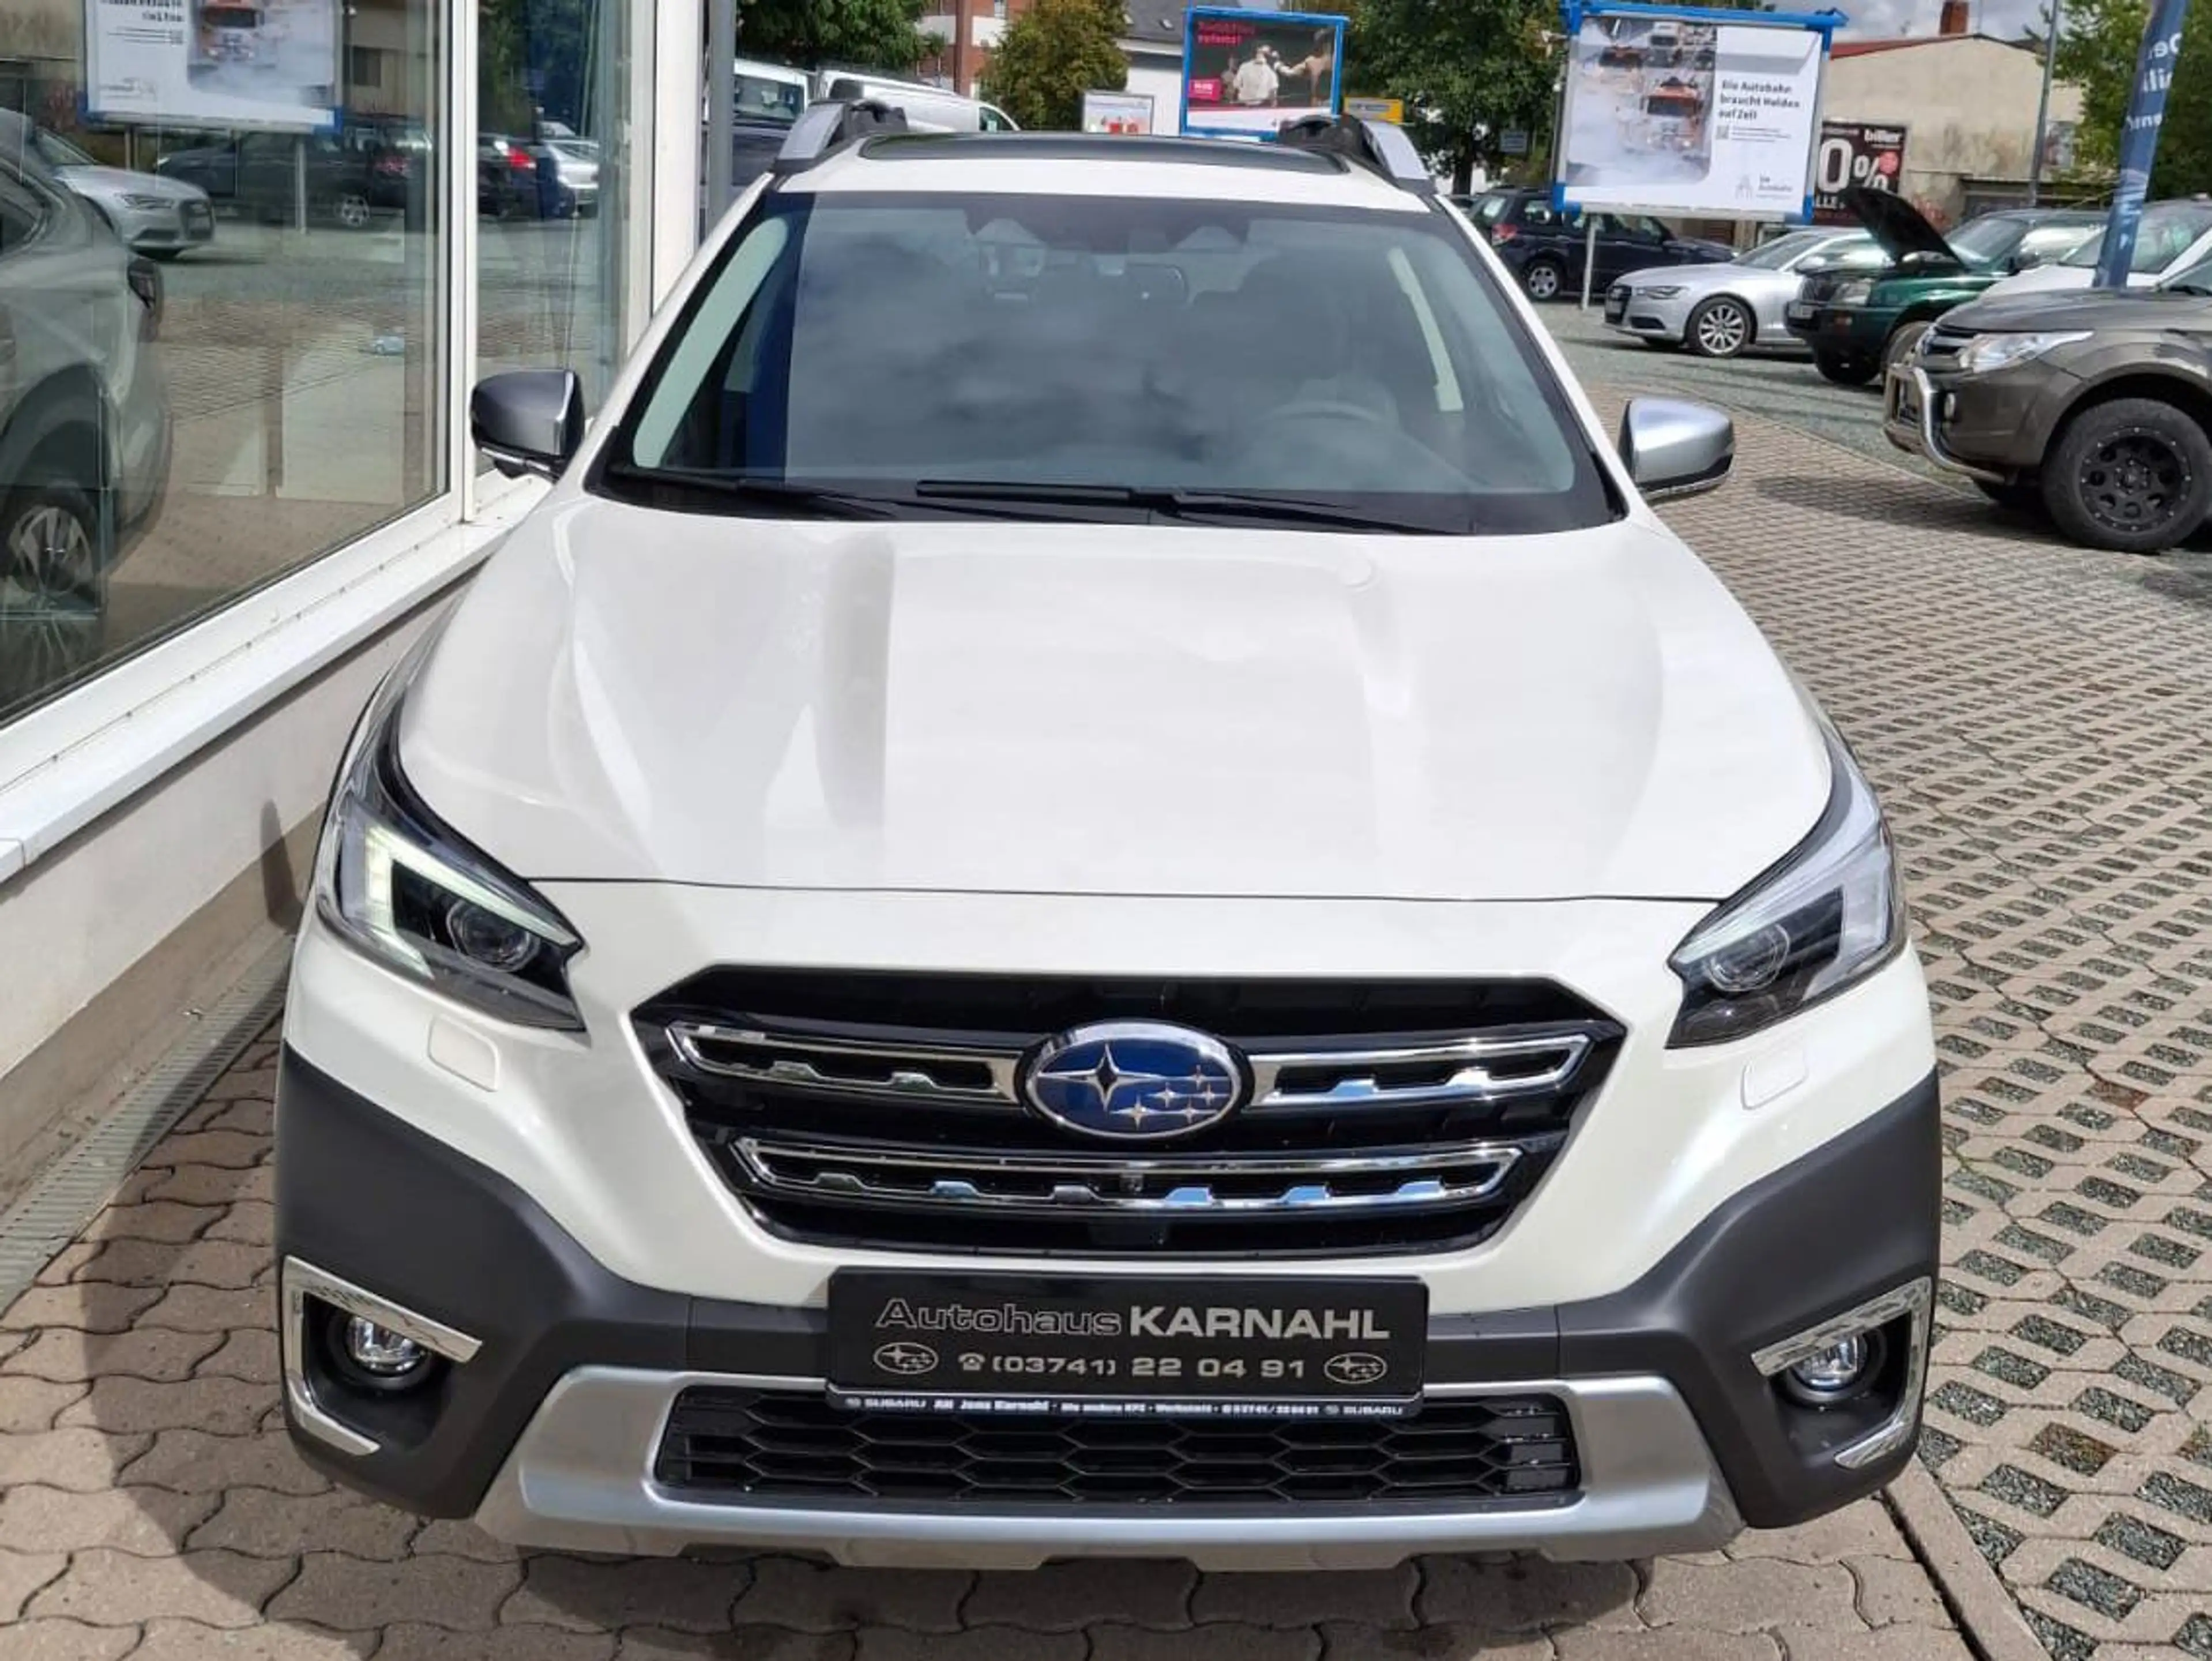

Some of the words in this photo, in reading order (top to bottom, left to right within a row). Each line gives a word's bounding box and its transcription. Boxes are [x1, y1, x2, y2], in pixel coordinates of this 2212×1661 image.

[1741, 81, 1792, 93] Autobahn
[1720, 93, 1760, 106] braucht
[875, 1298, 1122, 1336] Autohaus
[1130, 1305, 1390, 1340] KARNAHL
[992, 1355, 1116, 1376] (03741)
[1131, 1357, 1182, 1377] 22
[1197, 1358, 1247, 1378] 04
[1261, 1359, 1305, 1378] 91
[866, 1398, 926, 1408] SUBARU
[1343, 1406, 1404, 1415] SUBARU
